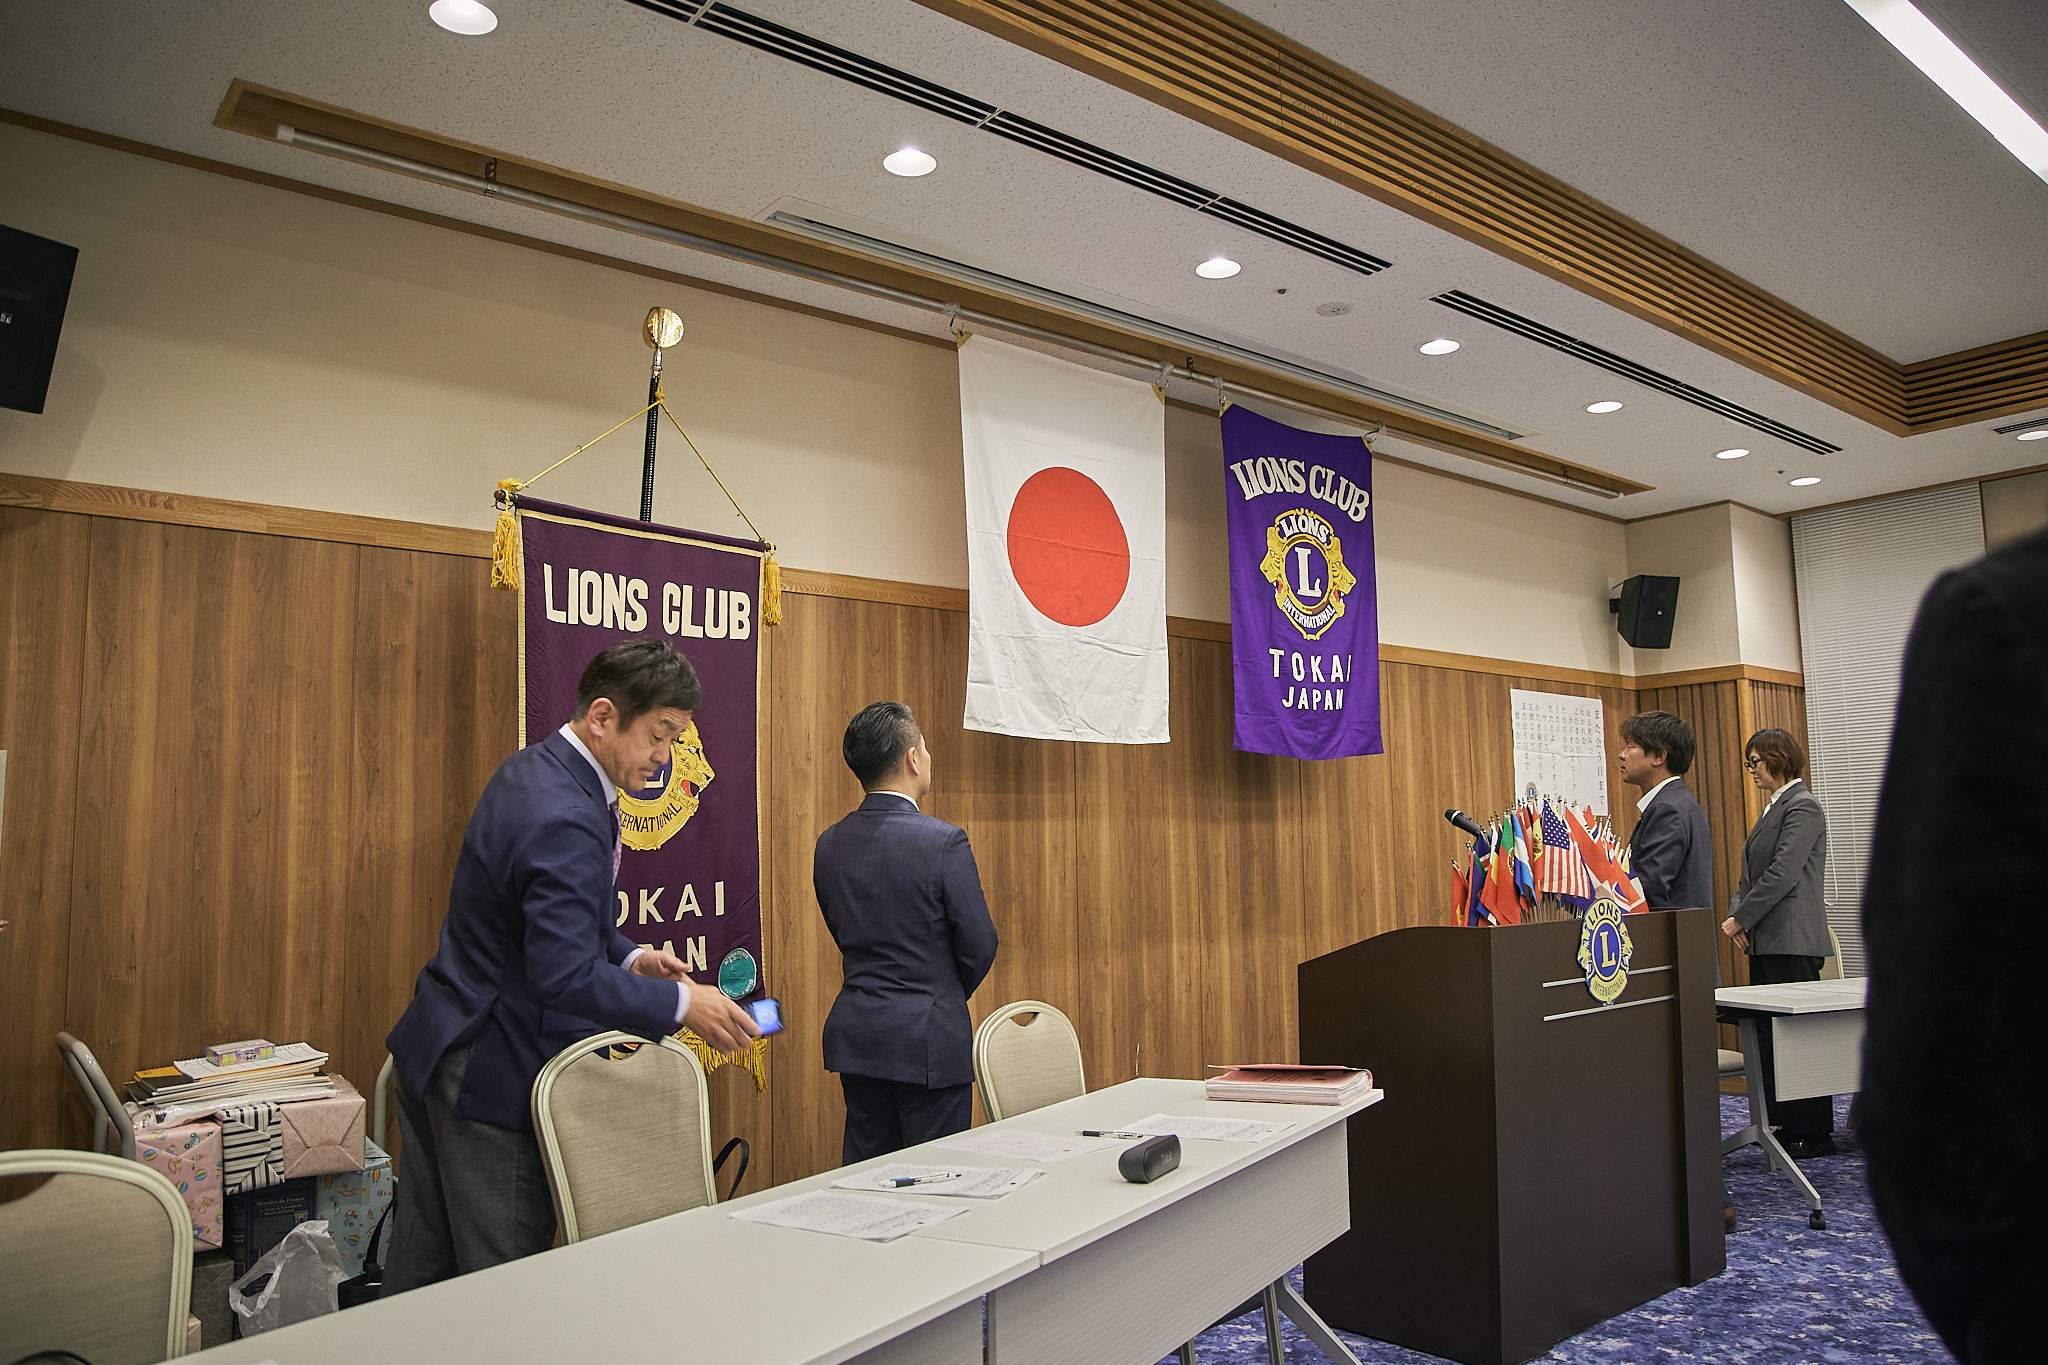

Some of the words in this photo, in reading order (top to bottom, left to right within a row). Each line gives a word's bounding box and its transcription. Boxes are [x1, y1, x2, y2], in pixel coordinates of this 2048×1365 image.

[1230, 456, 1306, 501] LIONS
[1309, 464, 1370, 522] CLUB
[1279, 514, 1330, 543] LIONS
[1294, 546, 1322, 598] L
[543, 562, 649, 633] LIONS
[662, 581, 751, 641] CLUB
[1283, 596, 1336, 629] INTERNATIONAL
[1268, 647, 1352, 683] TOKAI
[1281, 686, 1344, 711] JAPAN
[1594, 709, 1604, 805] また会う日まで
[616, 880, 725, 928] OKAI
[1588, 902, 1620, 926] LIONS
[1599, 930, 1616, 968] L
[1592, 974, 1625, 996] INTERNATIONAL
